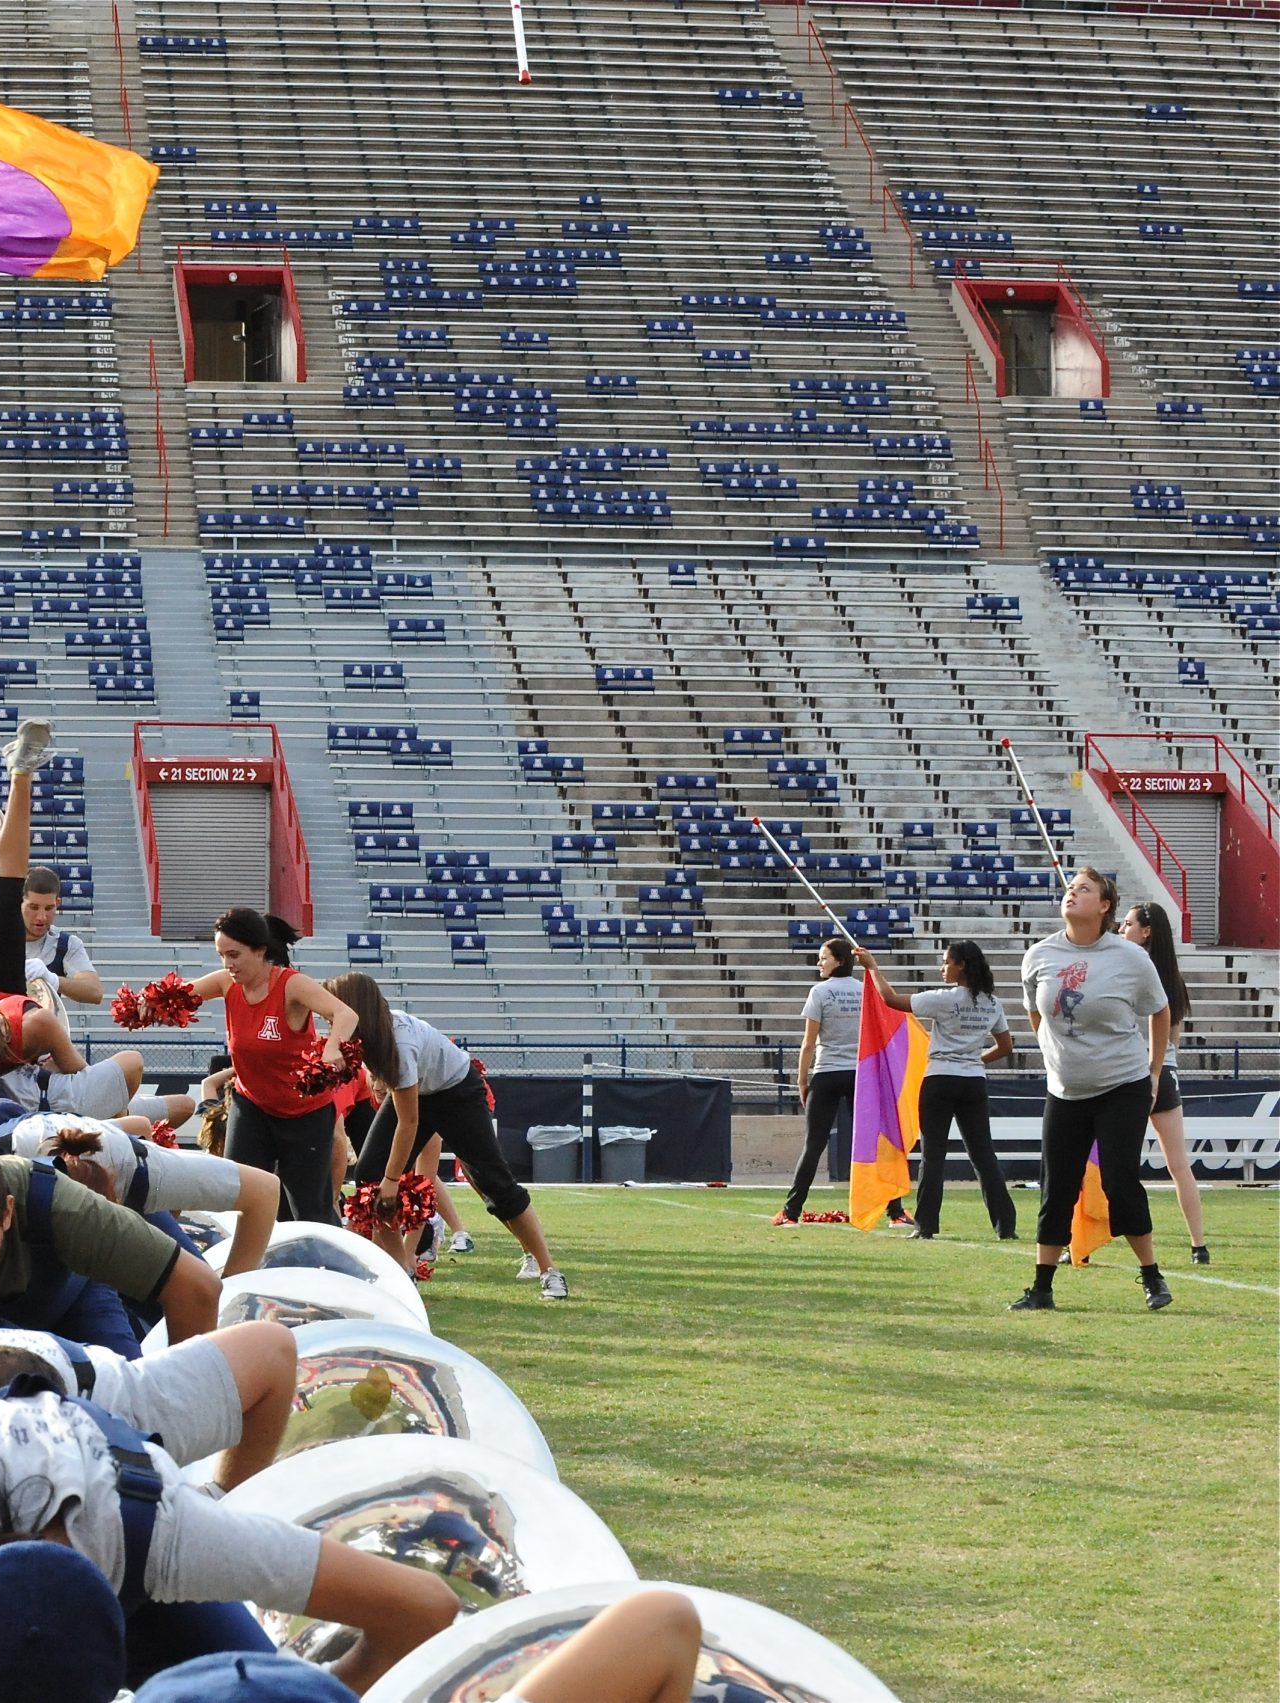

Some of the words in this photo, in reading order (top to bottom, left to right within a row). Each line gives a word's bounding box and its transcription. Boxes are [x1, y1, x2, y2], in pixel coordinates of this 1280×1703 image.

[170, 768, 182, 780] 21
[185, 768, 229, 781] SECTION
[232, 768, 245, 781] 22
[1129, 777, 1142, 790] 22
[1145, 778, 1186, 791] SECTION
[1188, 778, 1201, 791] 23
[257, 1015, 282, 1041] A
